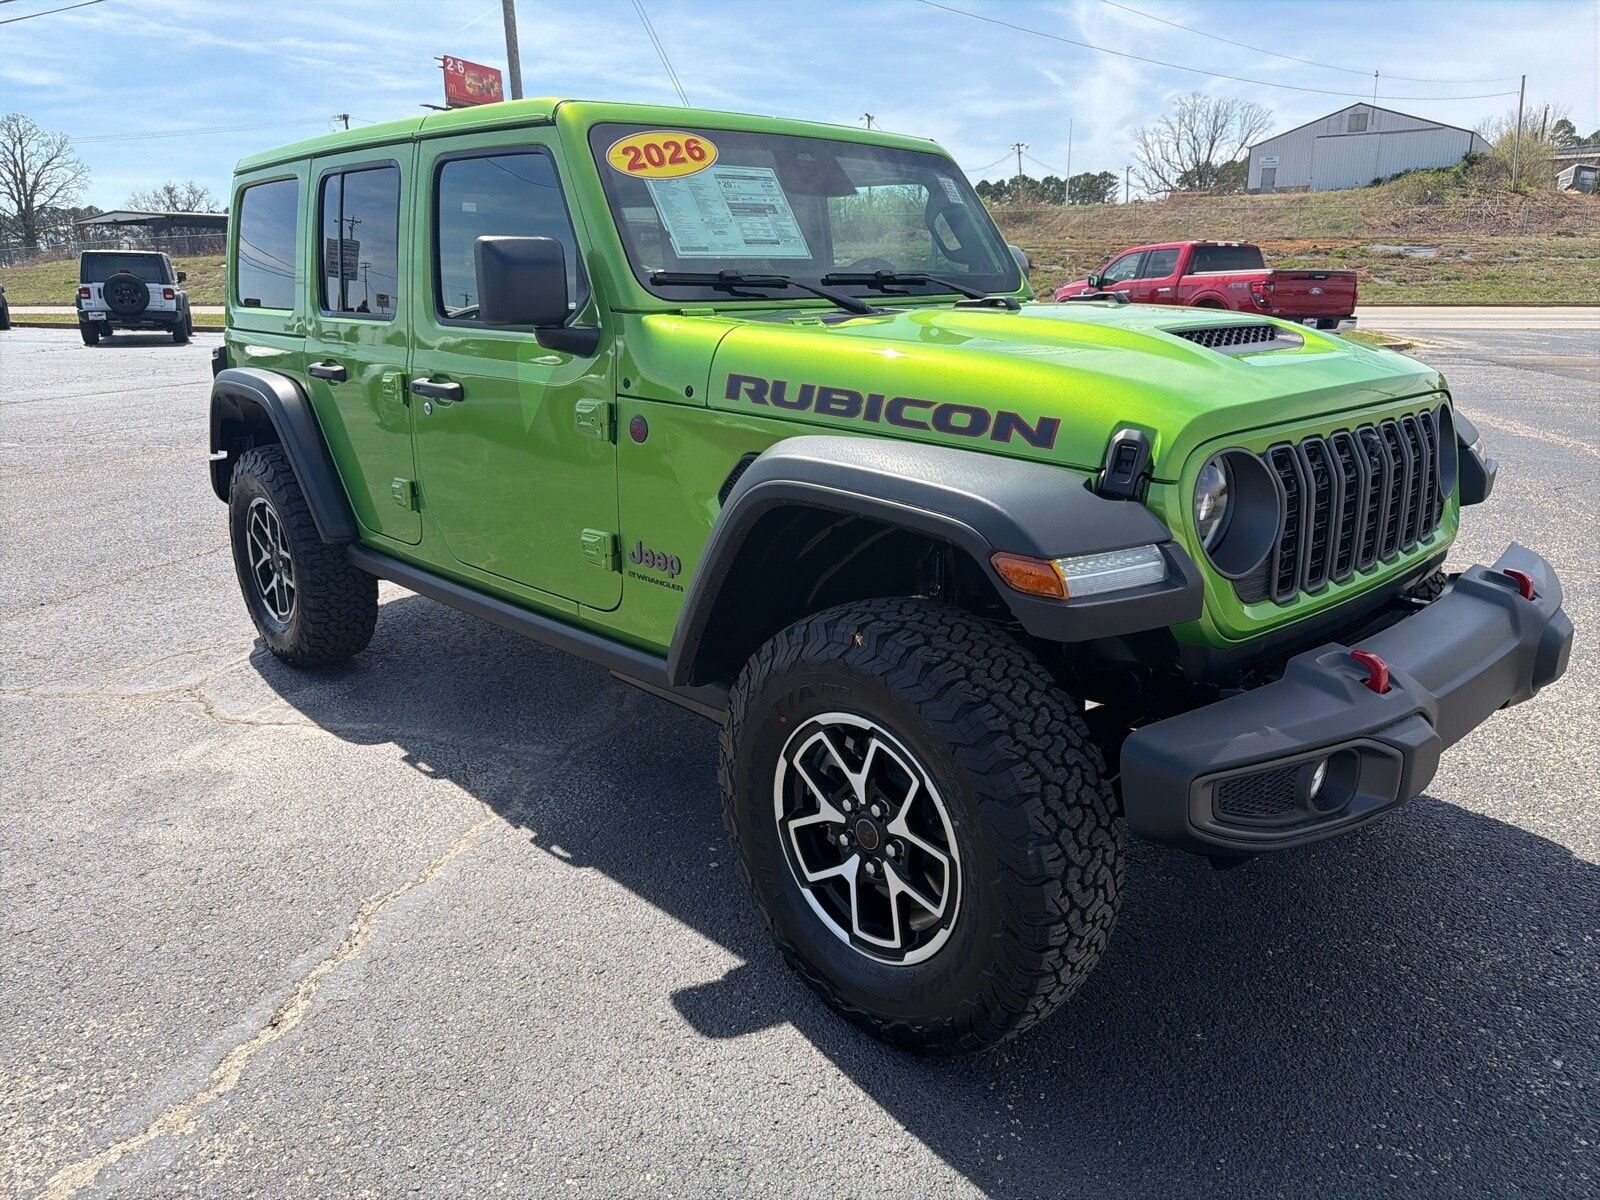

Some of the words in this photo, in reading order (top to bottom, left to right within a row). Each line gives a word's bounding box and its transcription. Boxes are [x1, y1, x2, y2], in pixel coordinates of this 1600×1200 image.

[622, 138, 708, 172] 2026
[724, 373, 1062, 450] RUBICON
[629, 540, 682, 579] Jeep
[636, 572, 684, 592] WRANGLER
